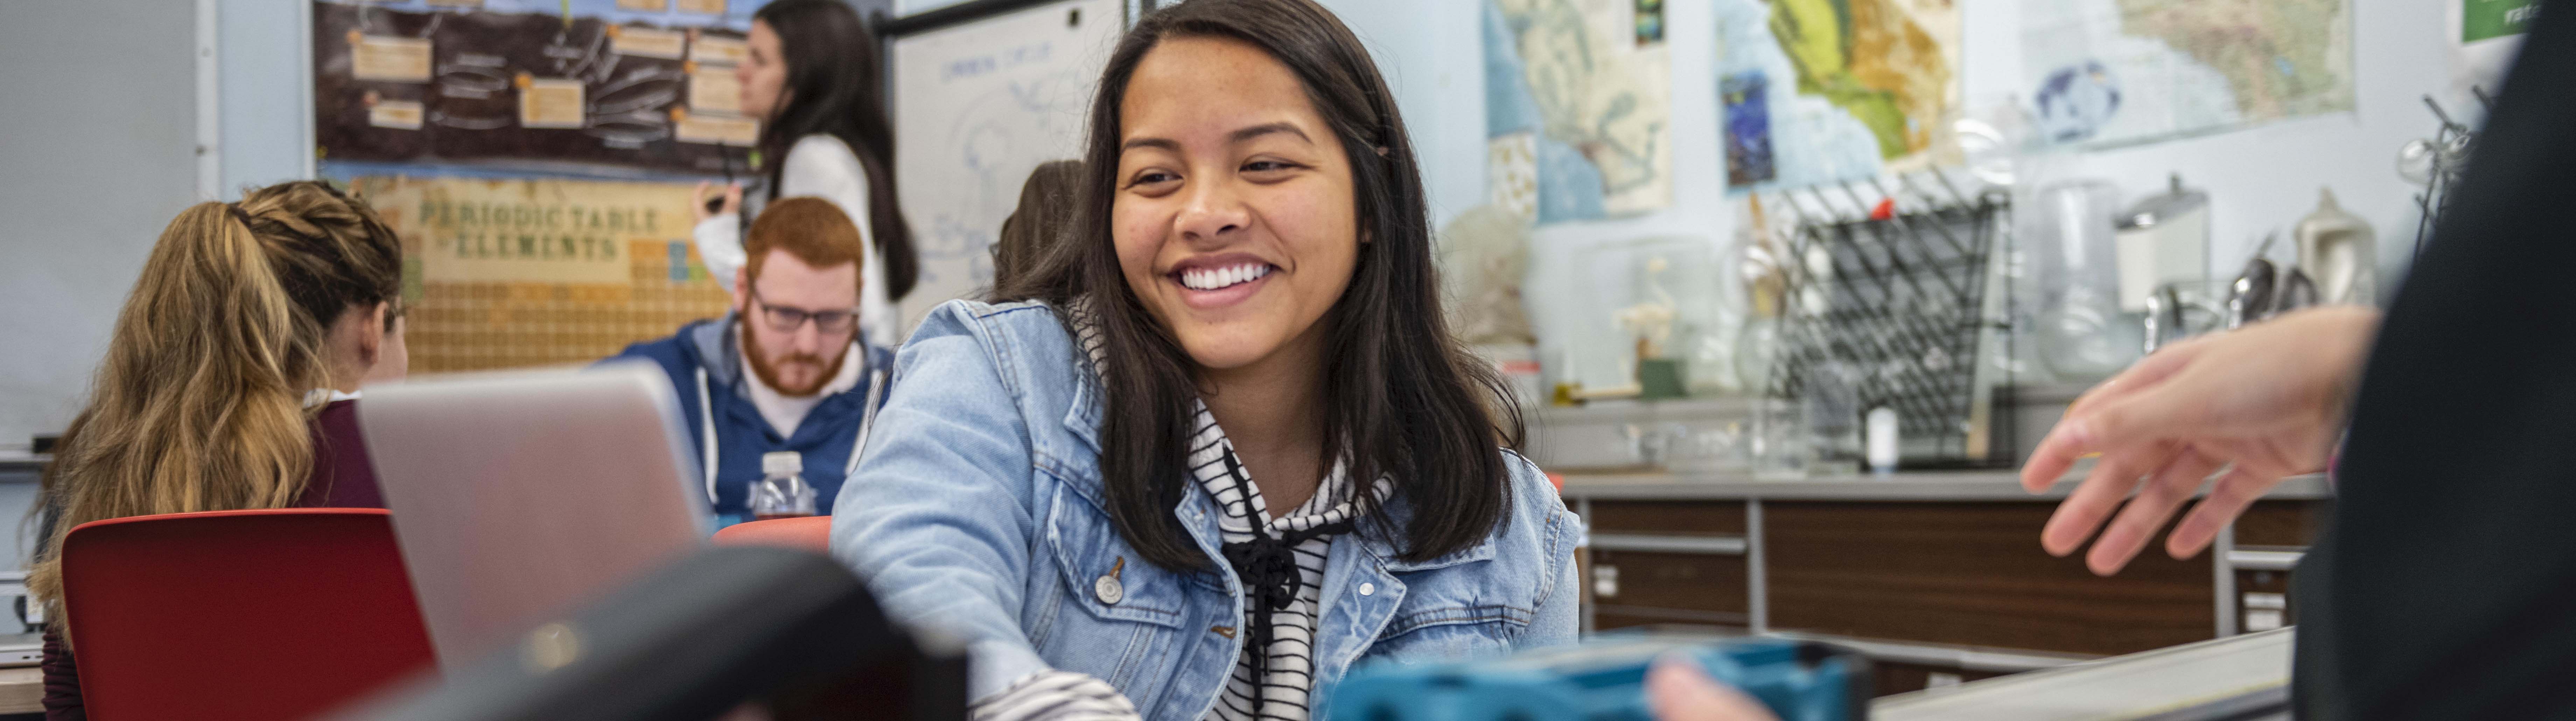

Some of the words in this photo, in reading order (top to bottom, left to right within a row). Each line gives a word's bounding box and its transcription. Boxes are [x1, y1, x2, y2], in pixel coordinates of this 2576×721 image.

[420, 200, 562, 229] PERIODIC
[569, 204, 658, 234] TABLE
[456, 232, 617, 260] ELEMENTS
